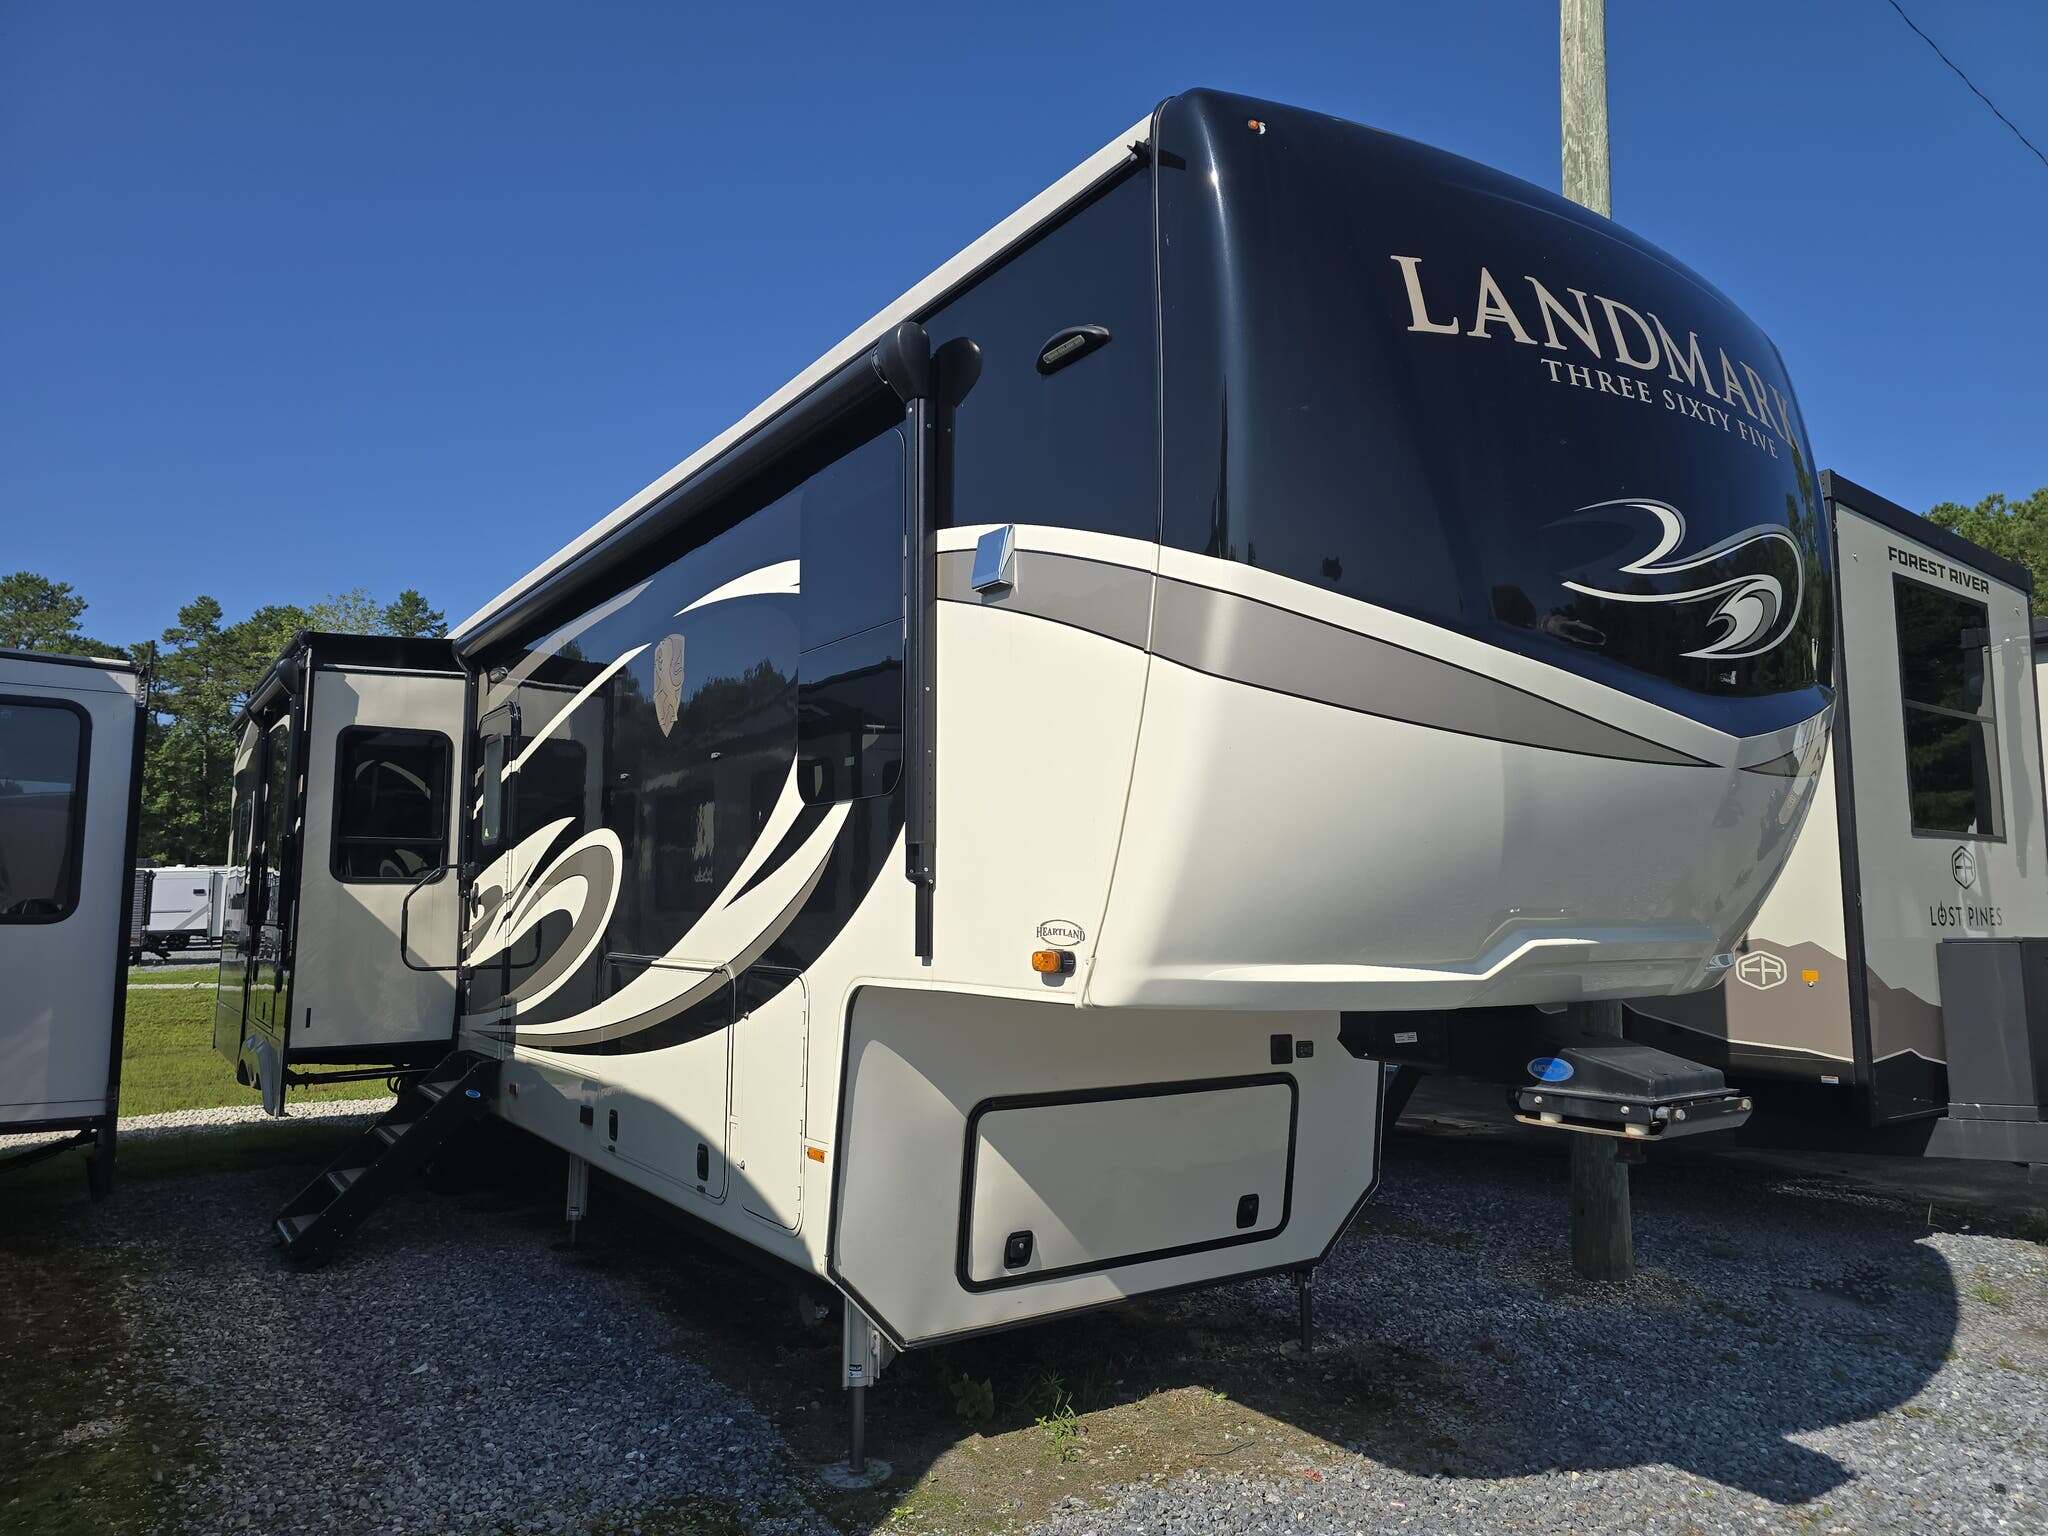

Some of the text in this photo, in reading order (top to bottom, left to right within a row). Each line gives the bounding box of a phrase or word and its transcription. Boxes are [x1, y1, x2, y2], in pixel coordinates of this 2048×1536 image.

[1390, 254, 1801, 455] LANDMARK
[1540, 358, 1779, 460] THREE SIXTY FIVE
[1887, 545, 1990, 595] FOREST RIVER
[1035, 925, 1086, 942] HEARTLAND
[1929, 900, 2004, 927] LOST PINES
